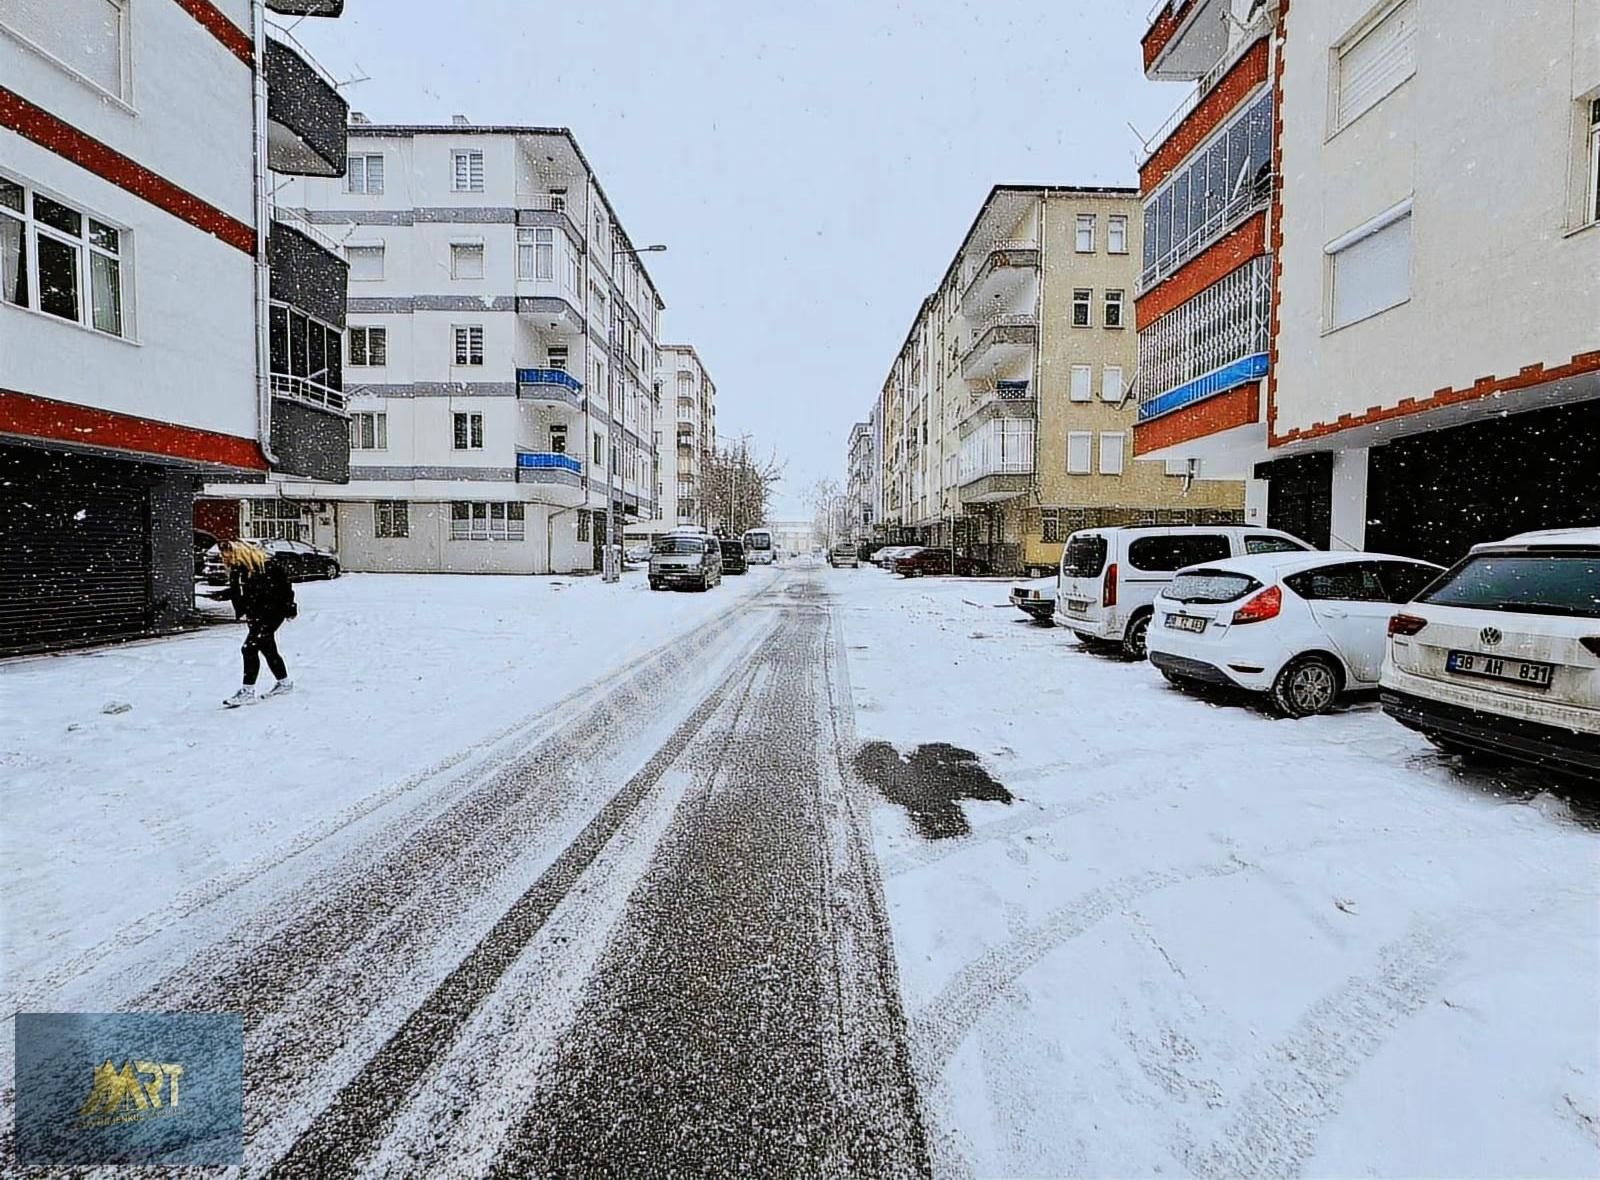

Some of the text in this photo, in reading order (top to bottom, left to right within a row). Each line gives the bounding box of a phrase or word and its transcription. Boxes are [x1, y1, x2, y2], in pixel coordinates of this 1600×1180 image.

[1456, 654, 1548, 683] 38 AH 831
